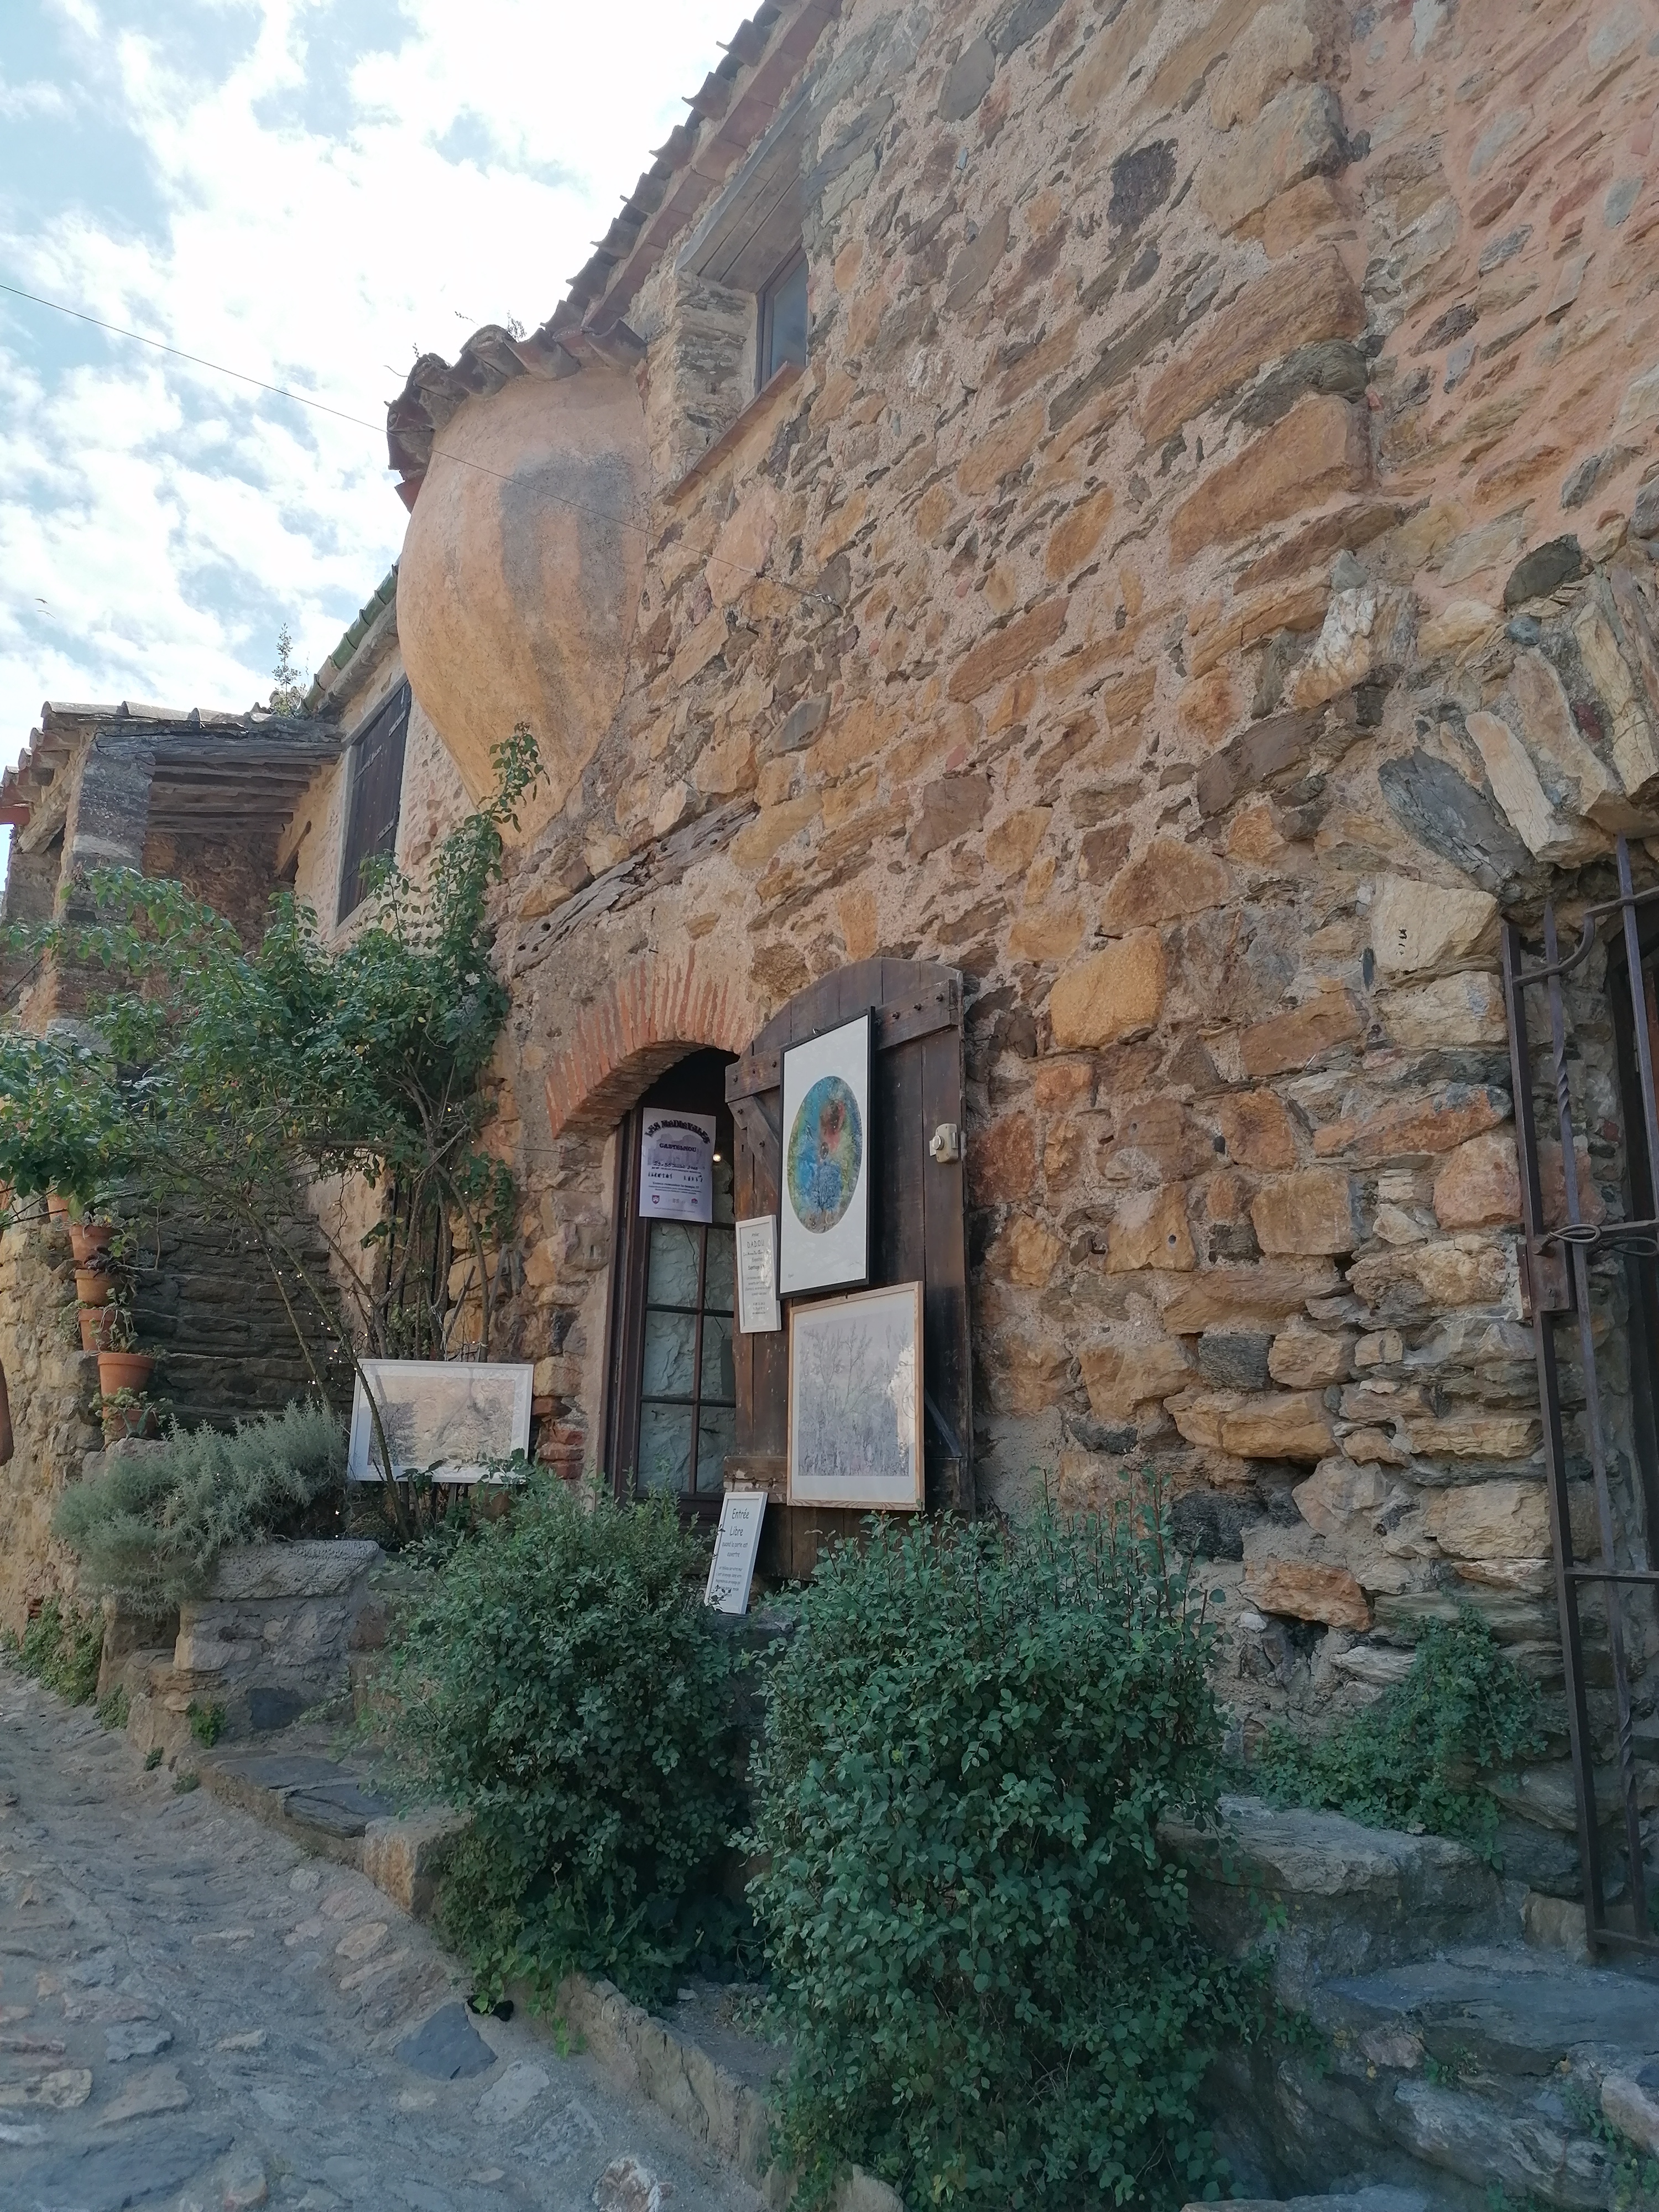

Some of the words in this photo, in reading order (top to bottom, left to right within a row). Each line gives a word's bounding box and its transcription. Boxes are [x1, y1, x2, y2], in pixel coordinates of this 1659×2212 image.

[644, 1121, 661, 1138] LES
[659, 1142, 697, 1152] CASTELNOU
[732, 1508, 749, 1519] Entrée
[729, 1526, 744, 1536] Libre
